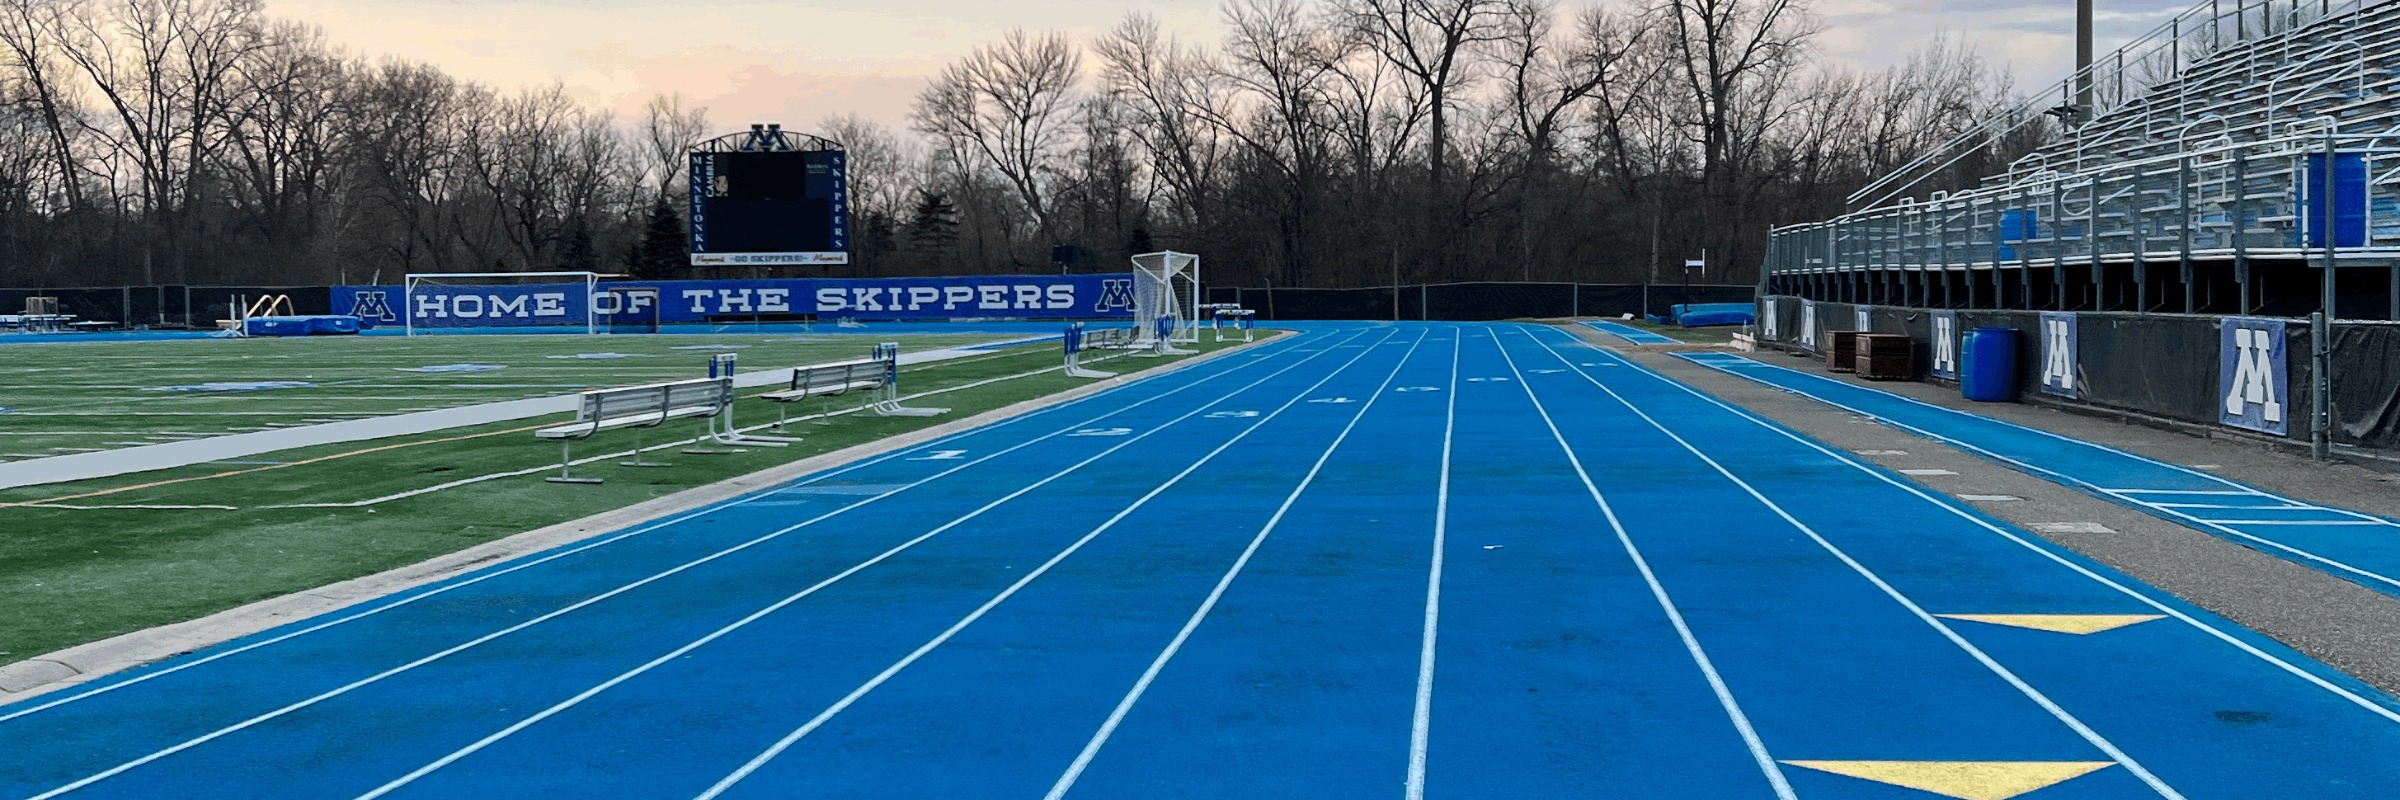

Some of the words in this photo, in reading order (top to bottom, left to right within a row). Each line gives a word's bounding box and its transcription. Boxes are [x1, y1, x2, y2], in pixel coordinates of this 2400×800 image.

[705, 154, 715, 198] CAMBRIA
[692, 156, 704, 252] MINNETONKA
[832, 156, 843, 249] SKIPPERS
[415, 292, 566, 319] HOME
[591, 290, 657, 315] OF
[682, 287, 790, 314] THE
[816, 283, 1077, 312] SKIPPERS
[1935, 316, 1955, 373] M
[2043, 319, 2073, 390] M
[2226, 328, 2281, 423] M
[1066, 427, 1133, 437] 2
[1203, 409, 1260, 419] 3
[906, 449, 968, 462] 1
